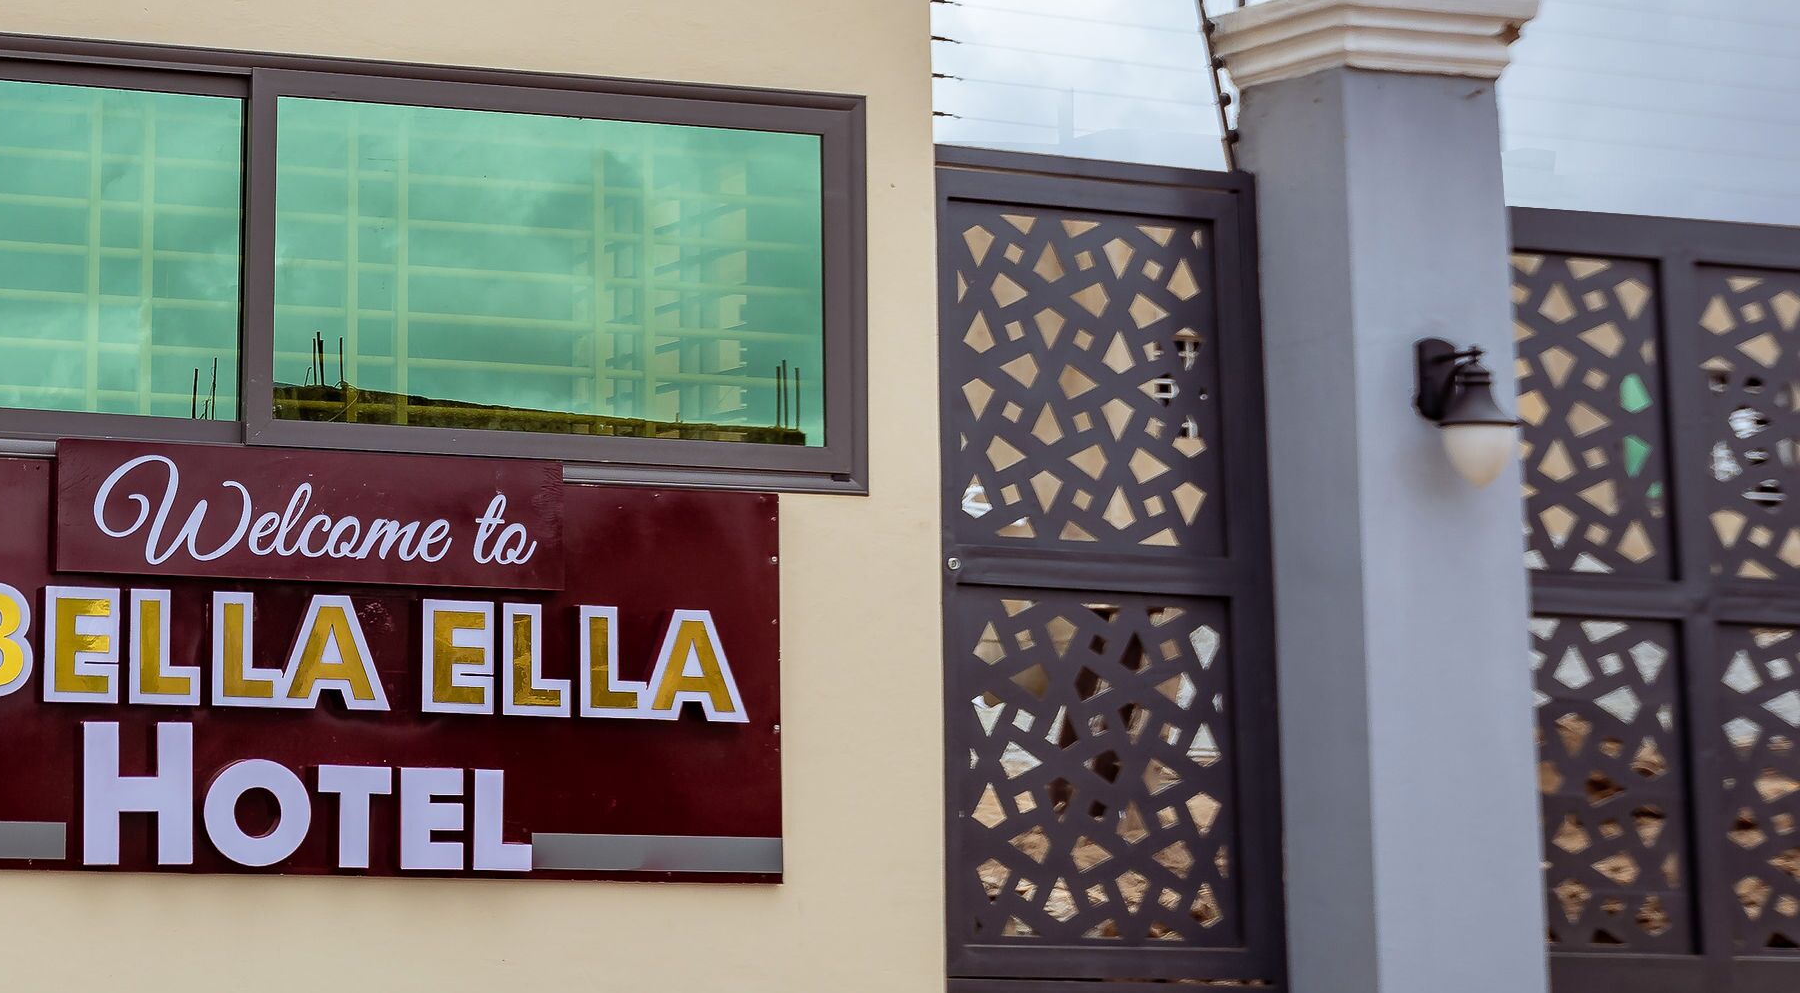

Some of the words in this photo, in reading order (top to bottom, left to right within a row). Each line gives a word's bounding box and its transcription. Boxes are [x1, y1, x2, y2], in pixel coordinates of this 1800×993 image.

[94, 455, 452, 564] Welcome
[472, 494, 536, 564] to
[421, 598, 749, 722] ELLA
